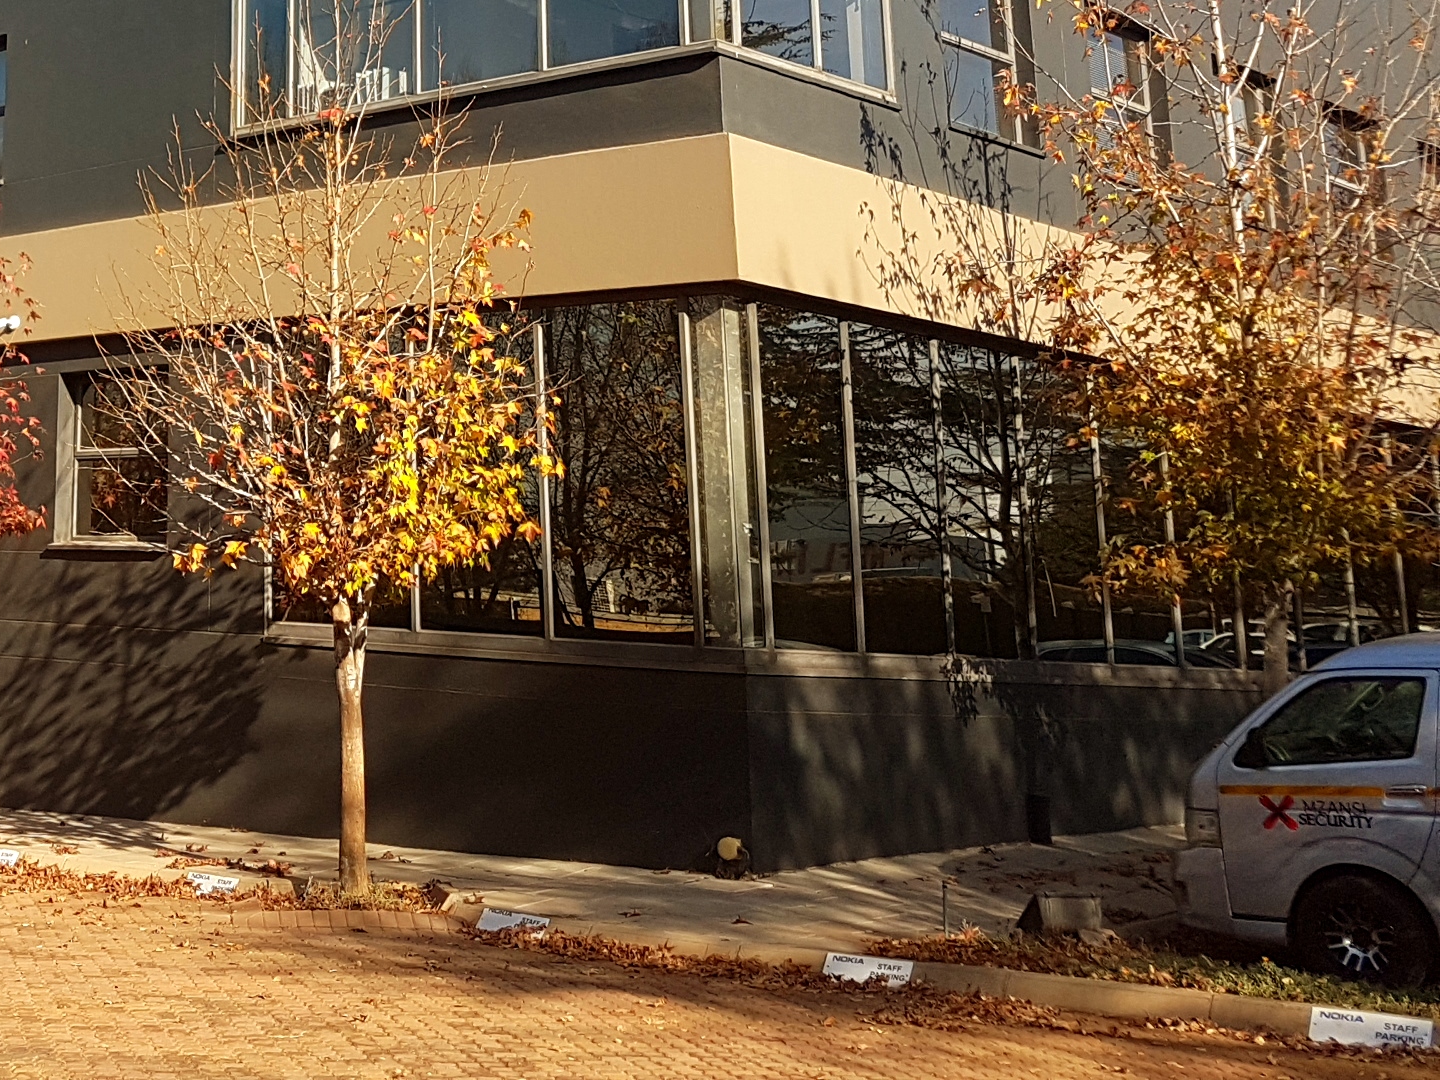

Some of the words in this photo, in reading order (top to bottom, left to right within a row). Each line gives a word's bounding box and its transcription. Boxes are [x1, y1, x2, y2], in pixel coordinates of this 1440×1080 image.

[1302, 799, 1367, 814] MZANSI
[1298, 812, 1373, 829] SECURITY
[521, 917, 542, 926] STAFF
[832, 955, 865, 965] NOKIA
[877, 963, 903, 973] STAFF
[1320, 1011, 1364, 1023] NOKIA
[1383, 1022, 1419, 1034] STAFF
[1375, 1031, 1425, 1045] PARKING
